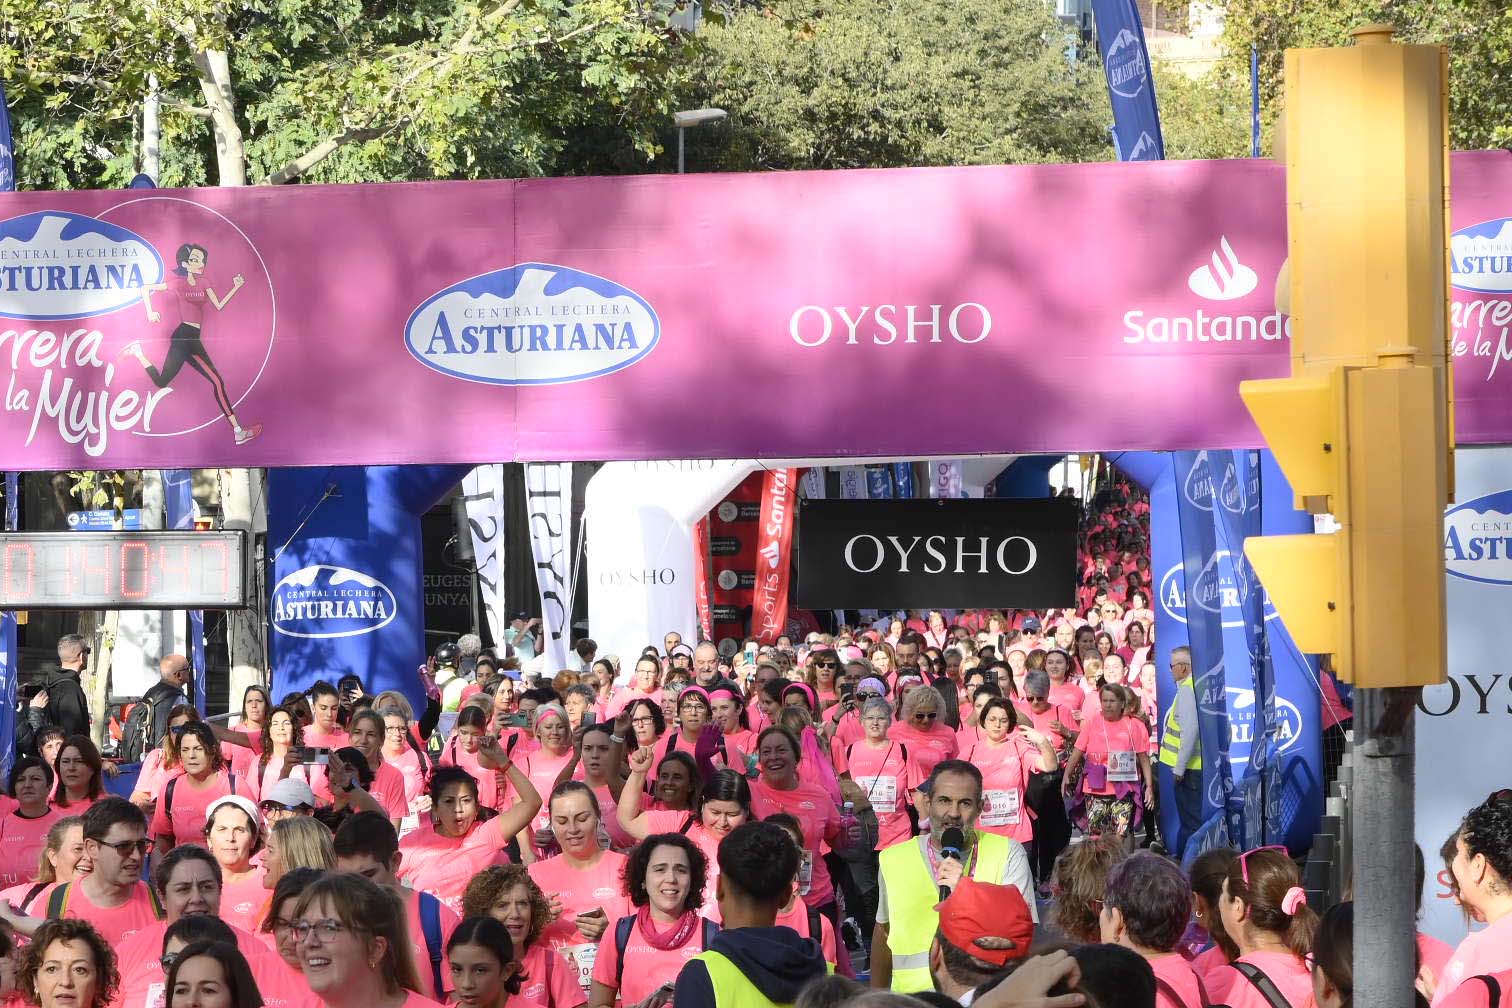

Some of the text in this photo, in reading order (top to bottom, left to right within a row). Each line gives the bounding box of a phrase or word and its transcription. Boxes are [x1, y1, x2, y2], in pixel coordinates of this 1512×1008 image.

[67, 247, 139, 258] LECHERA
[463, 304, 632, 318] CENTRAL LECHERA
[789, 302, 992, 346] OYSHO
[424, 310, 640, 355] ASTURIANA
[5, 373, 30, 411] la
[25, 362, 173, 456] Mujer
[844, 534, 1038, 575] OYSHO
[286, 588, 382, 598] CENTRAL LECHERA
[599, 567, 675, 586] OYSHO
[274, 595, 386, 622] ASTURIANA
[757, 572, 779, 640] Sports
[1416, 674, 1512, 717] OY
[2, 873, 17, 883] TU
